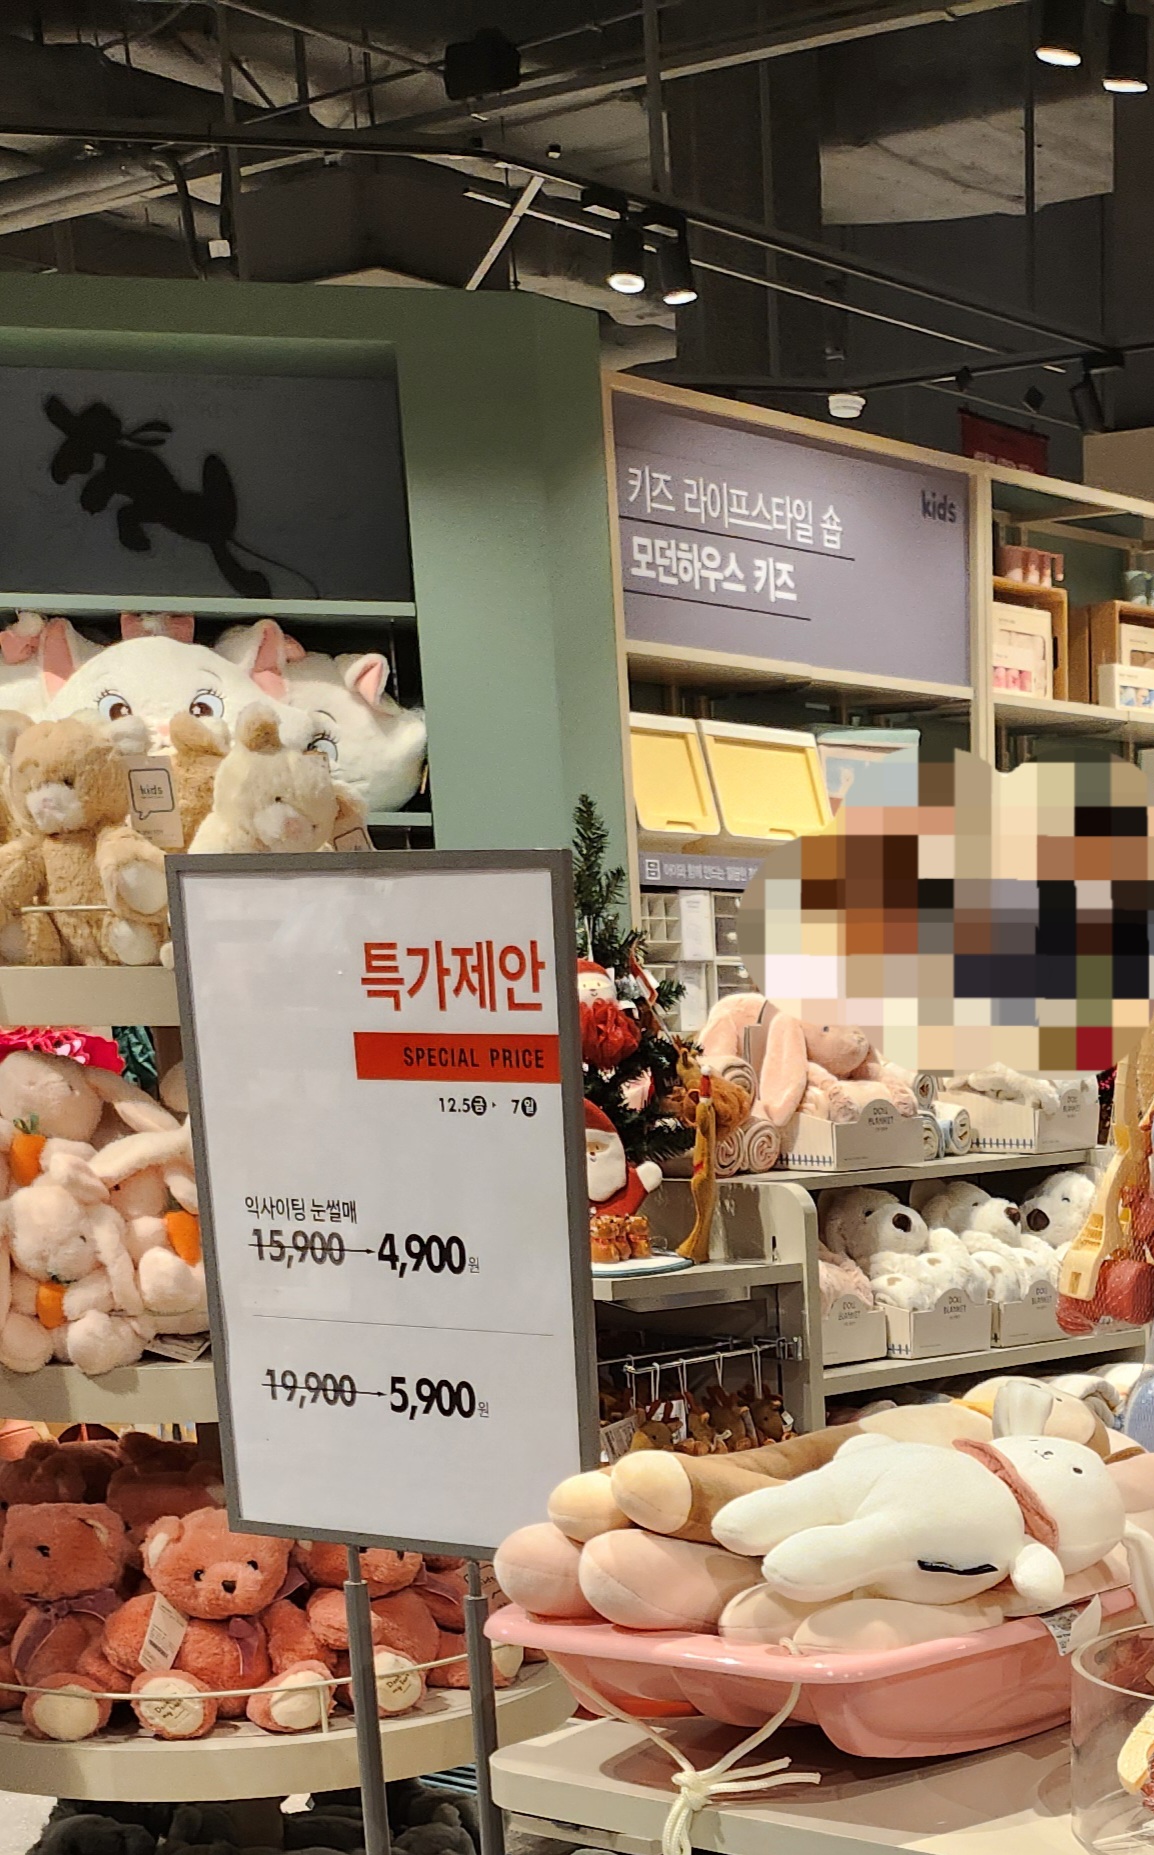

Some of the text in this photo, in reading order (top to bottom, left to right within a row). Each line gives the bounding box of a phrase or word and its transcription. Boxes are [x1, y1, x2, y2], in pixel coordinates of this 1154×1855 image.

[628, 465, 843, 549] 키즈 라이프스타일 숍
[920, 490, 957, 524] kids
[631, 535, 798, 603] 모던하우스 키즈
[139, 784, 163, 795] kids
[360, 940, 546, 1012] 특가제안
[403, 1046, 545, 1069] SPECIAL PRICE
[244, 1196, 358, 1224] 익사이팅 눈썰매
[251, 1228, 346, 1269] 15,900
[264, 1369, 357, 1408] 19,900
